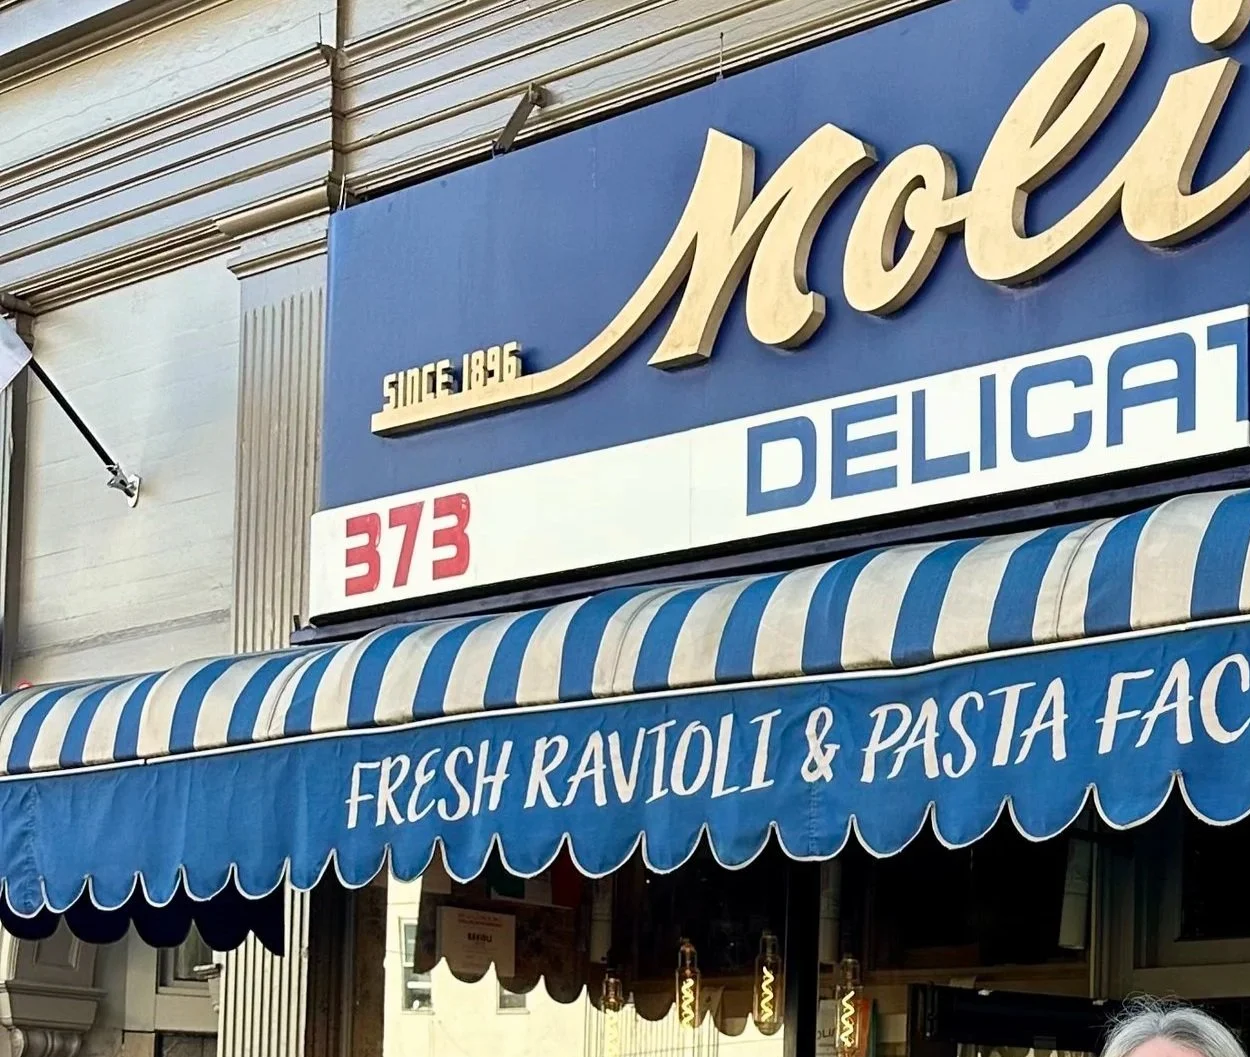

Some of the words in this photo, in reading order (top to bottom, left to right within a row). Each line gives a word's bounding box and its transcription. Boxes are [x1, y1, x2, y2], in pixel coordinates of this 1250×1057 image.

[383, 358, 457, 412] SINCE
[463, 340, 523, 391] 1896
[344, 492, 471, 597] 373
[346, 739, 513, 829] FRESH
[524, 708, 782, 810] RAVIOLI
[801, 706, 841, 783] &
[860, 677, 1069, 784] PASTA
